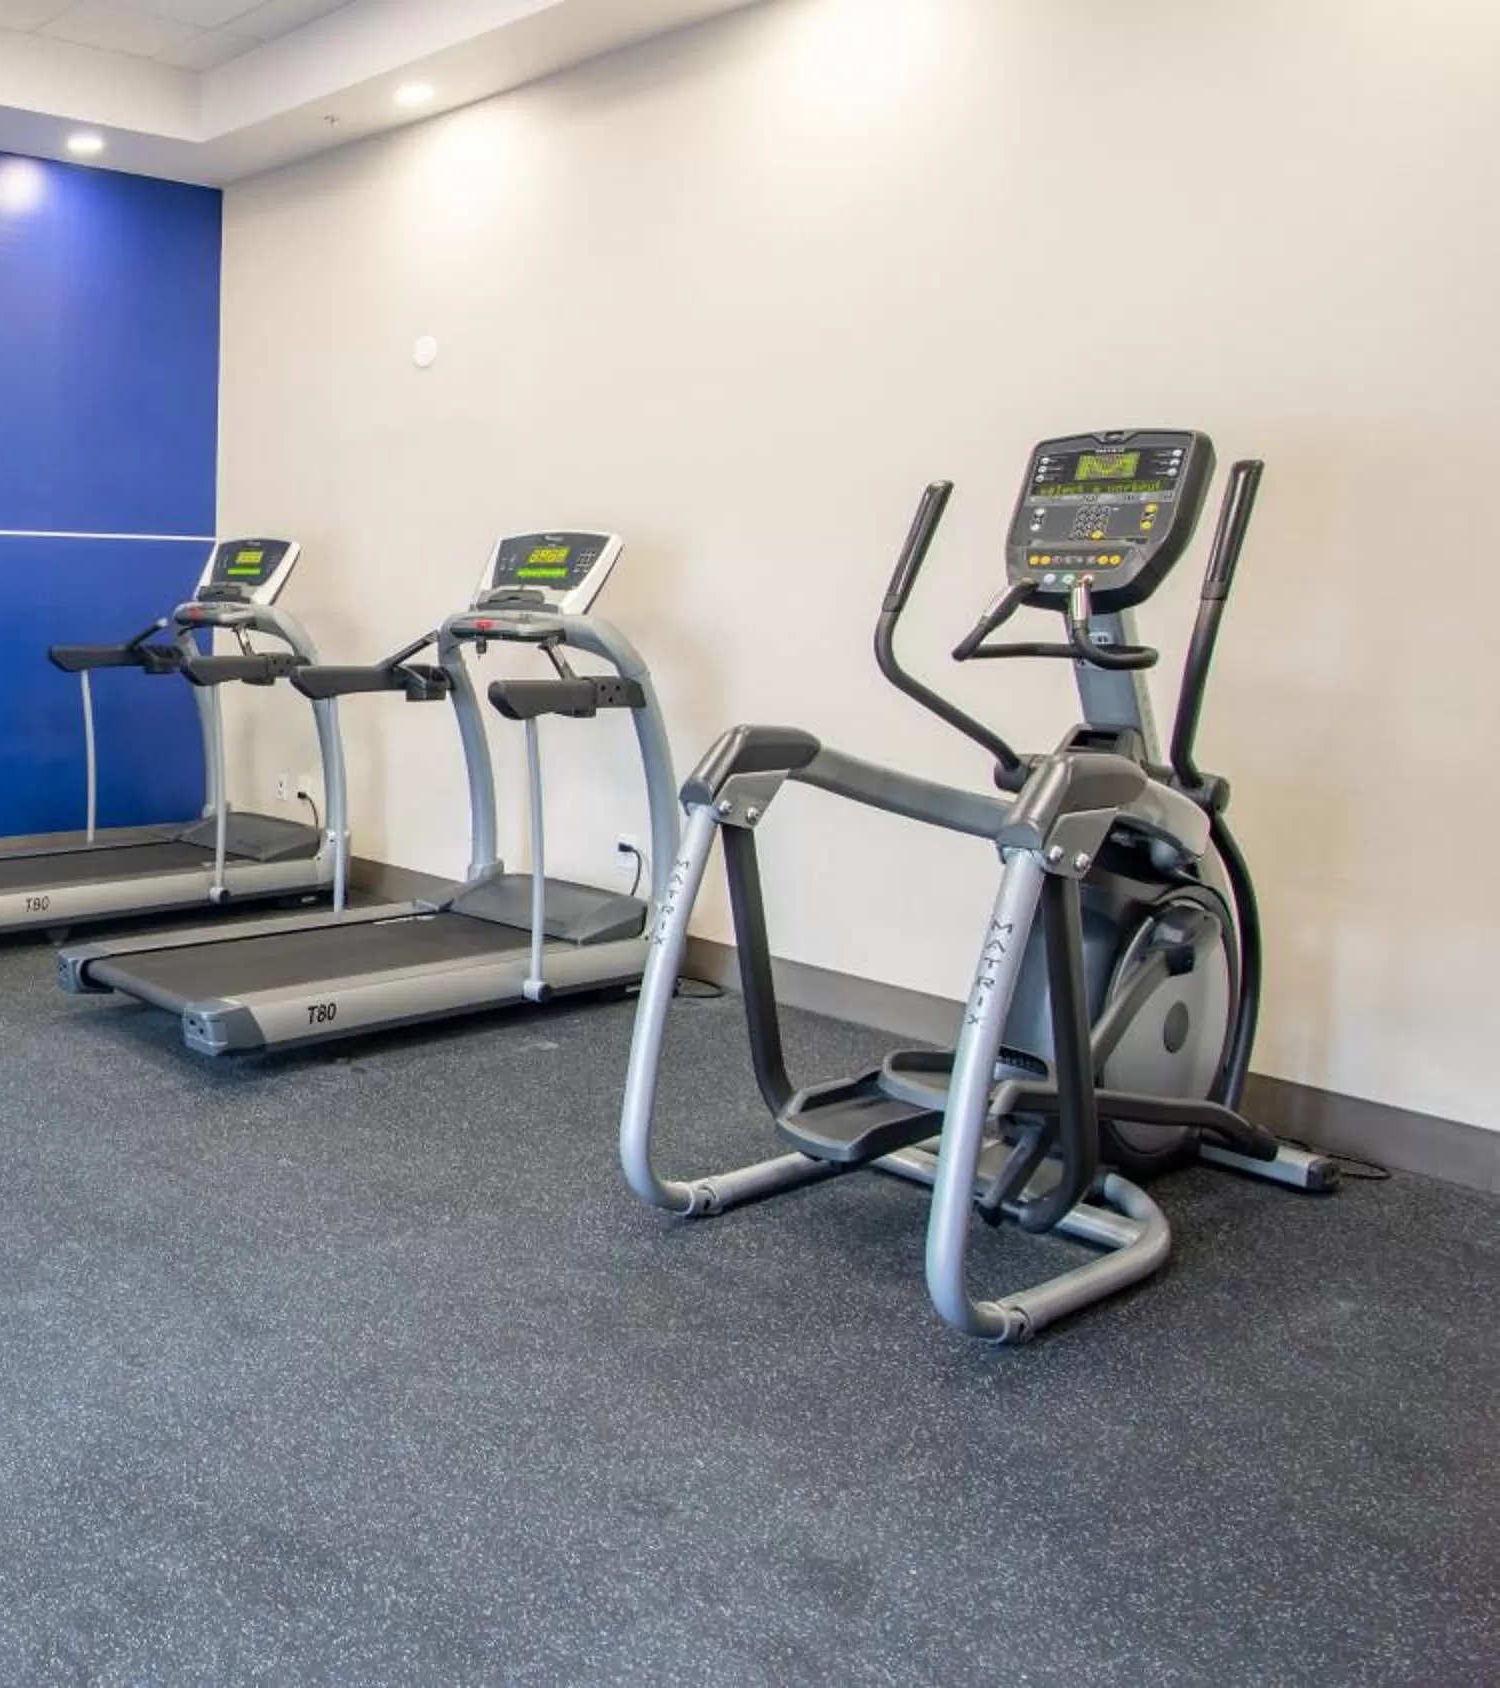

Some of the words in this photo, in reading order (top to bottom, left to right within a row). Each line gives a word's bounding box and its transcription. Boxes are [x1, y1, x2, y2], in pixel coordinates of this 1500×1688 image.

[653, 860, 691, 945] MATRIX
[308, 1002, 337, 1025] T80
[967, 920, 1013, 1025] MATRIX
